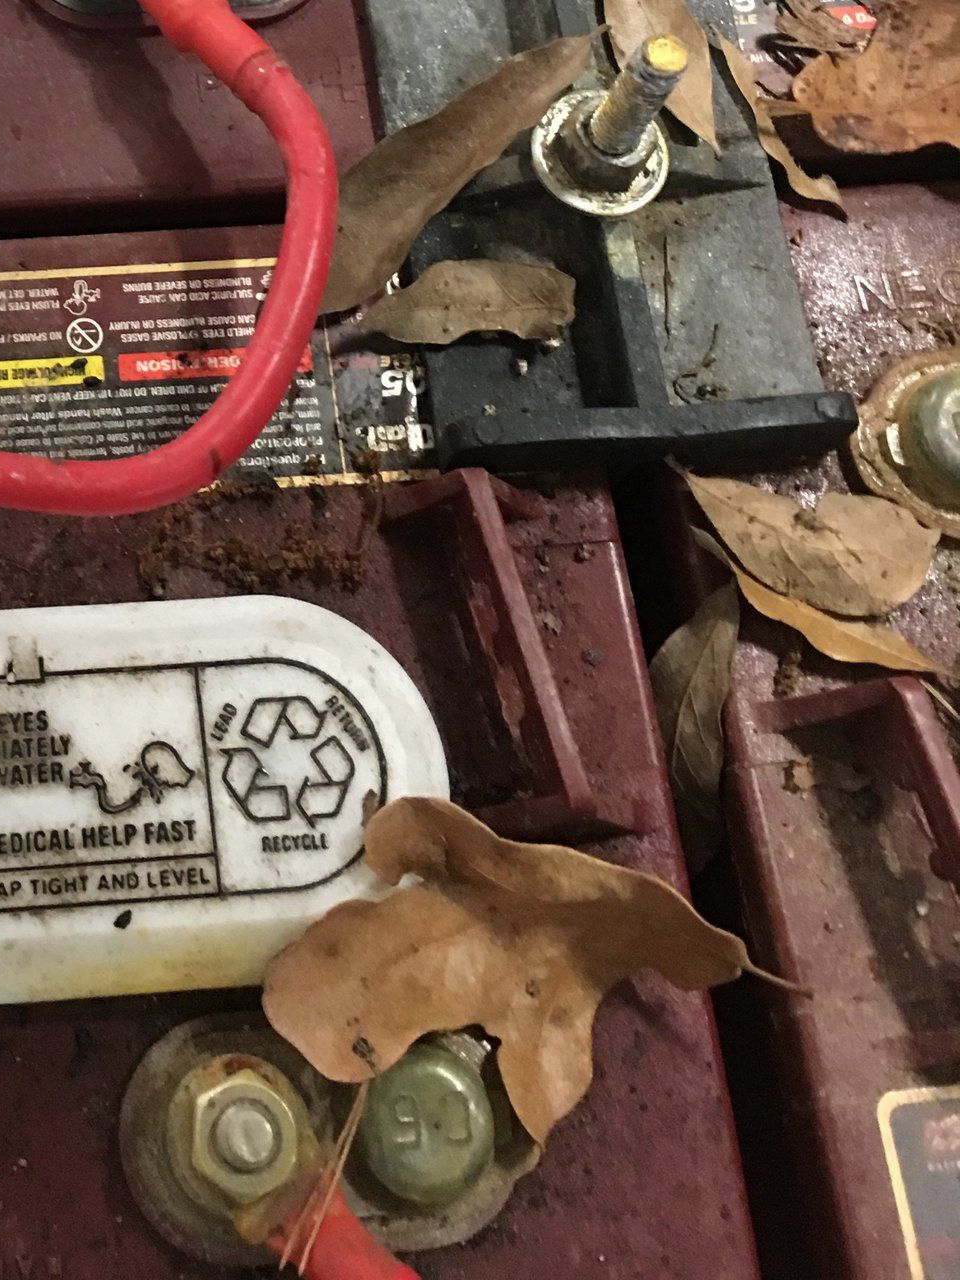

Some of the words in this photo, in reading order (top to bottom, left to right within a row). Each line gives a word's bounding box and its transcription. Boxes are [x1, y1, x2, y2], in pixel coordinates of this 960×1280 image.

[208, 702, 239, 743] LEAD
[323, 694, 370, 754] RETURN
[81, 823, 138, 849] HELP
[144, 819, 197, 845] FAST
[259, 831, 330, 855] RECYCLE
[29, 874, 89, 898] TIGHT
[96, 871, 141, 892] AND
[145, 866, 211, 889] LEVEL
